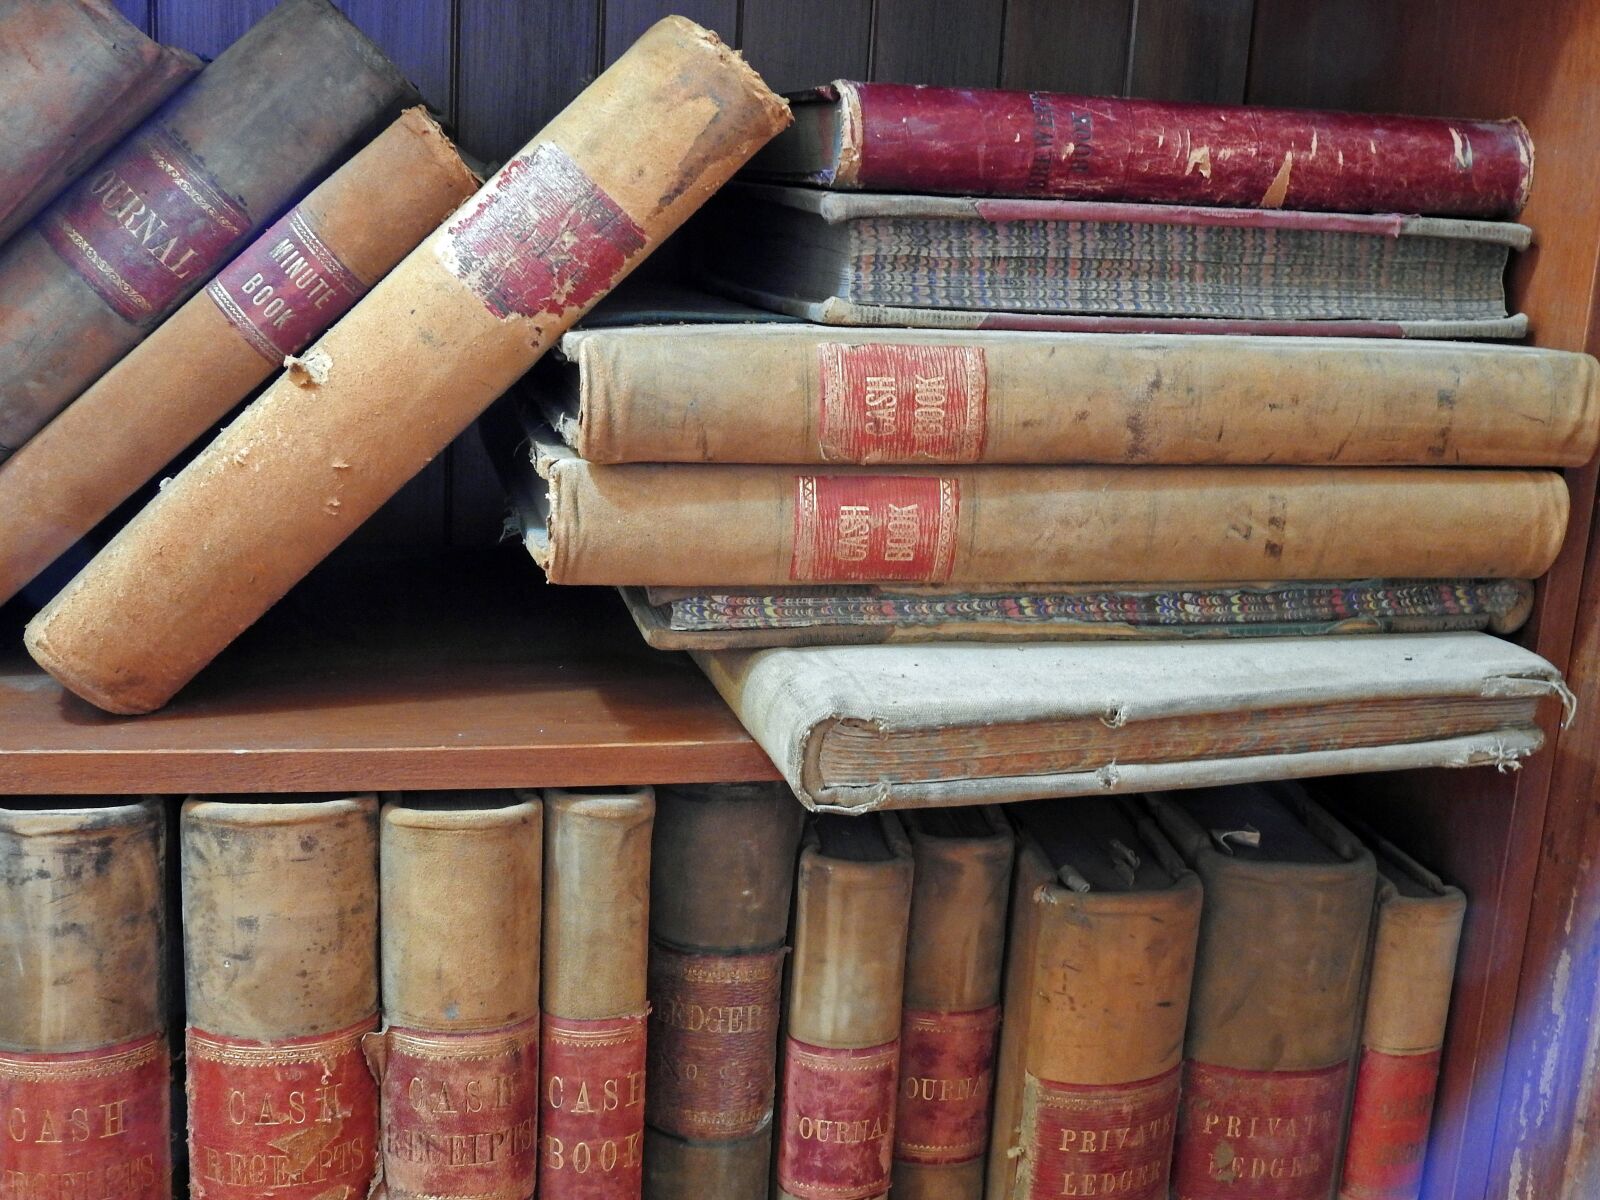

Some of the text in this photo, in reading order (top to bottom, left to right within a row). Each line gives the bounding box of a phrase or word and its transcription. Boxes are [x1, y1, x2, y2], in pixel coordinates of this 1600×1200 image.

[91, 170, 199, 279] OURNAL
[241, 273, 296, 329] BOOK
[269, 238, 337, 309] MINUTE
[865, 376, 897, 436] CASH
[914, 374, 946, 436] BOOK
[837, 505, 870, 561] CASH
[884, 503, 918, 561] BOOK
[229, 1083, 351, 1126] CASH
[408, 1073, 516, 1113] CASH
[905, 1076, 983, 1102] OURNA
[9, 1099, 129, 1142] CASH
[797, 1115, 889, 1144] OURNA
[545, 1130, 641, 1174] BOOK
